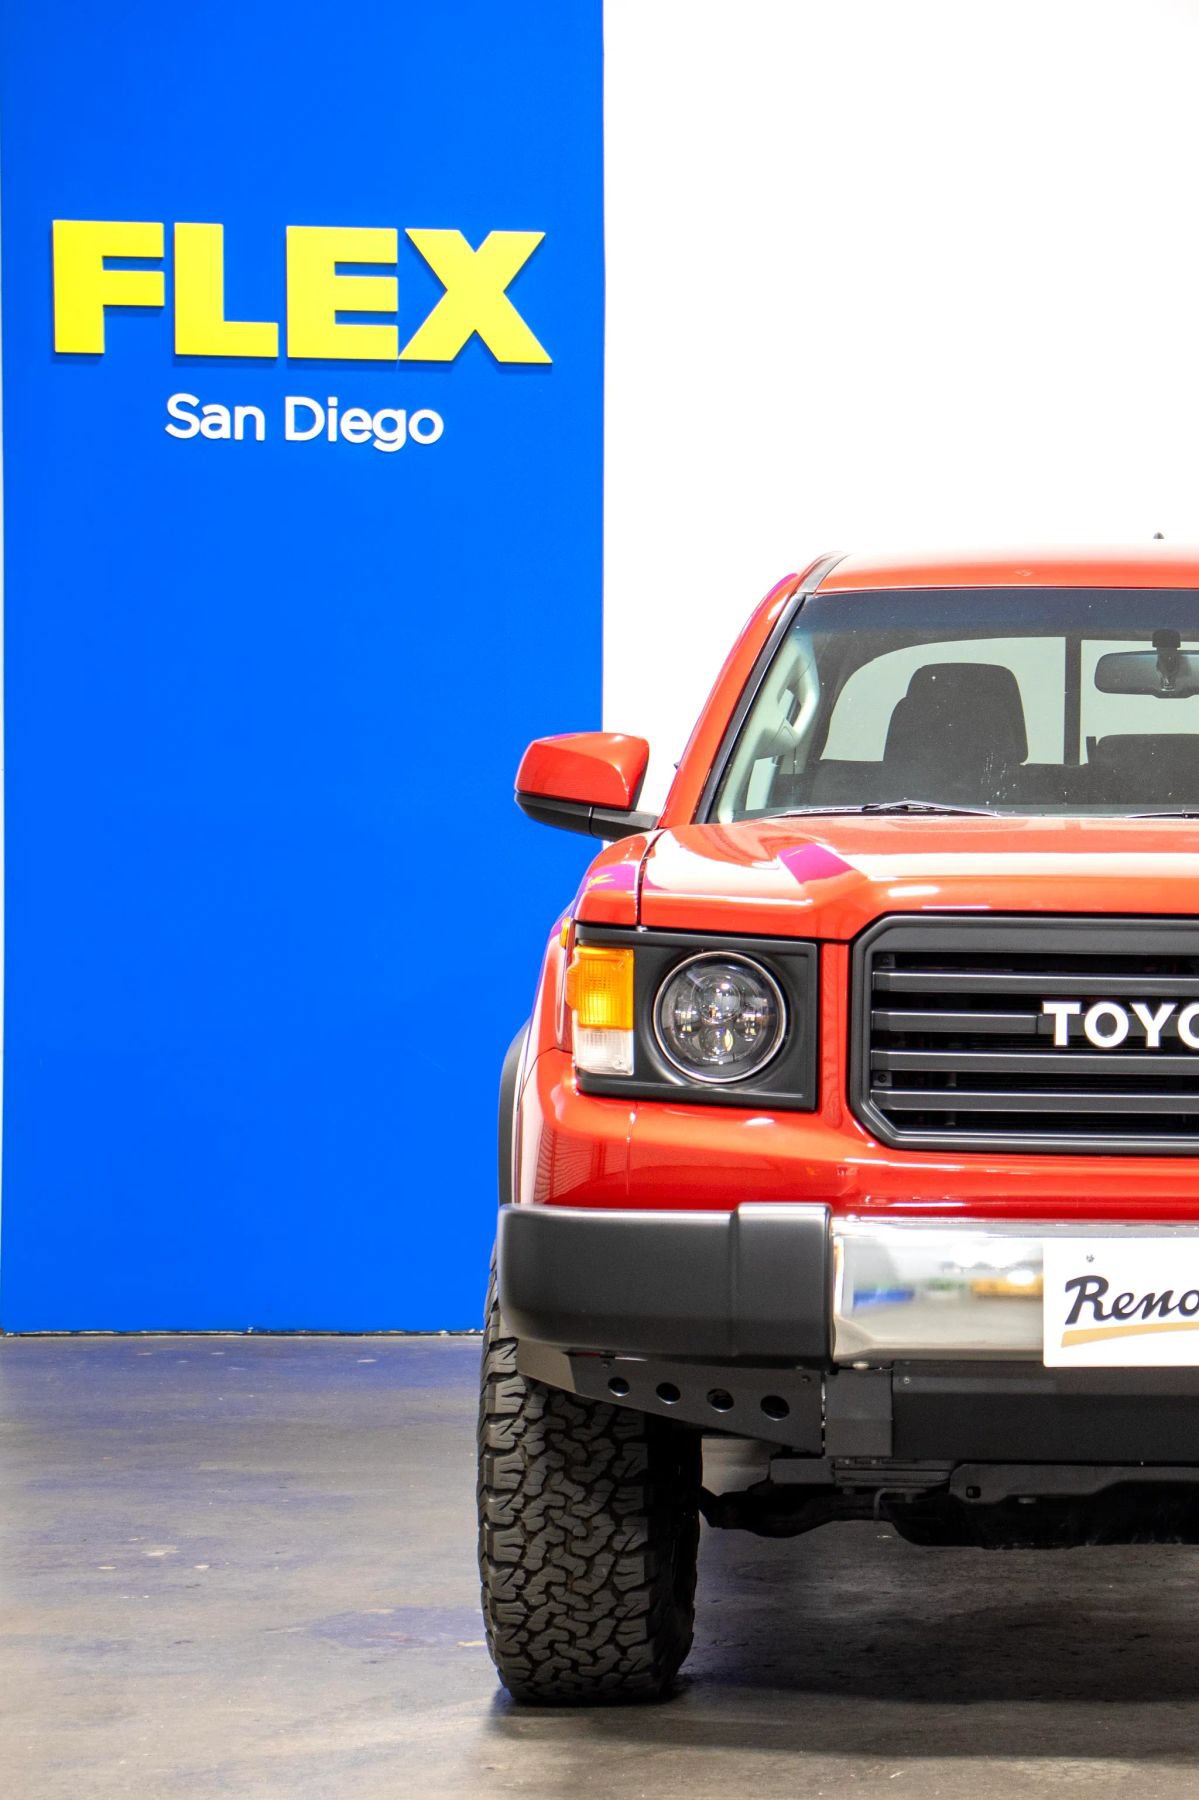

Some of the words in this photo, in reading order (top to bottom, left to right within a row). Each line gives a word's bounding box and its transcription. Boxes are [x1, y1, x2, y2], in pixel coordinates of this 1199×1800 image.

[52, 220, 553, 364] FLEX
[164, 393, 266, 441] San
[284, 396, 445, 453] Diego
